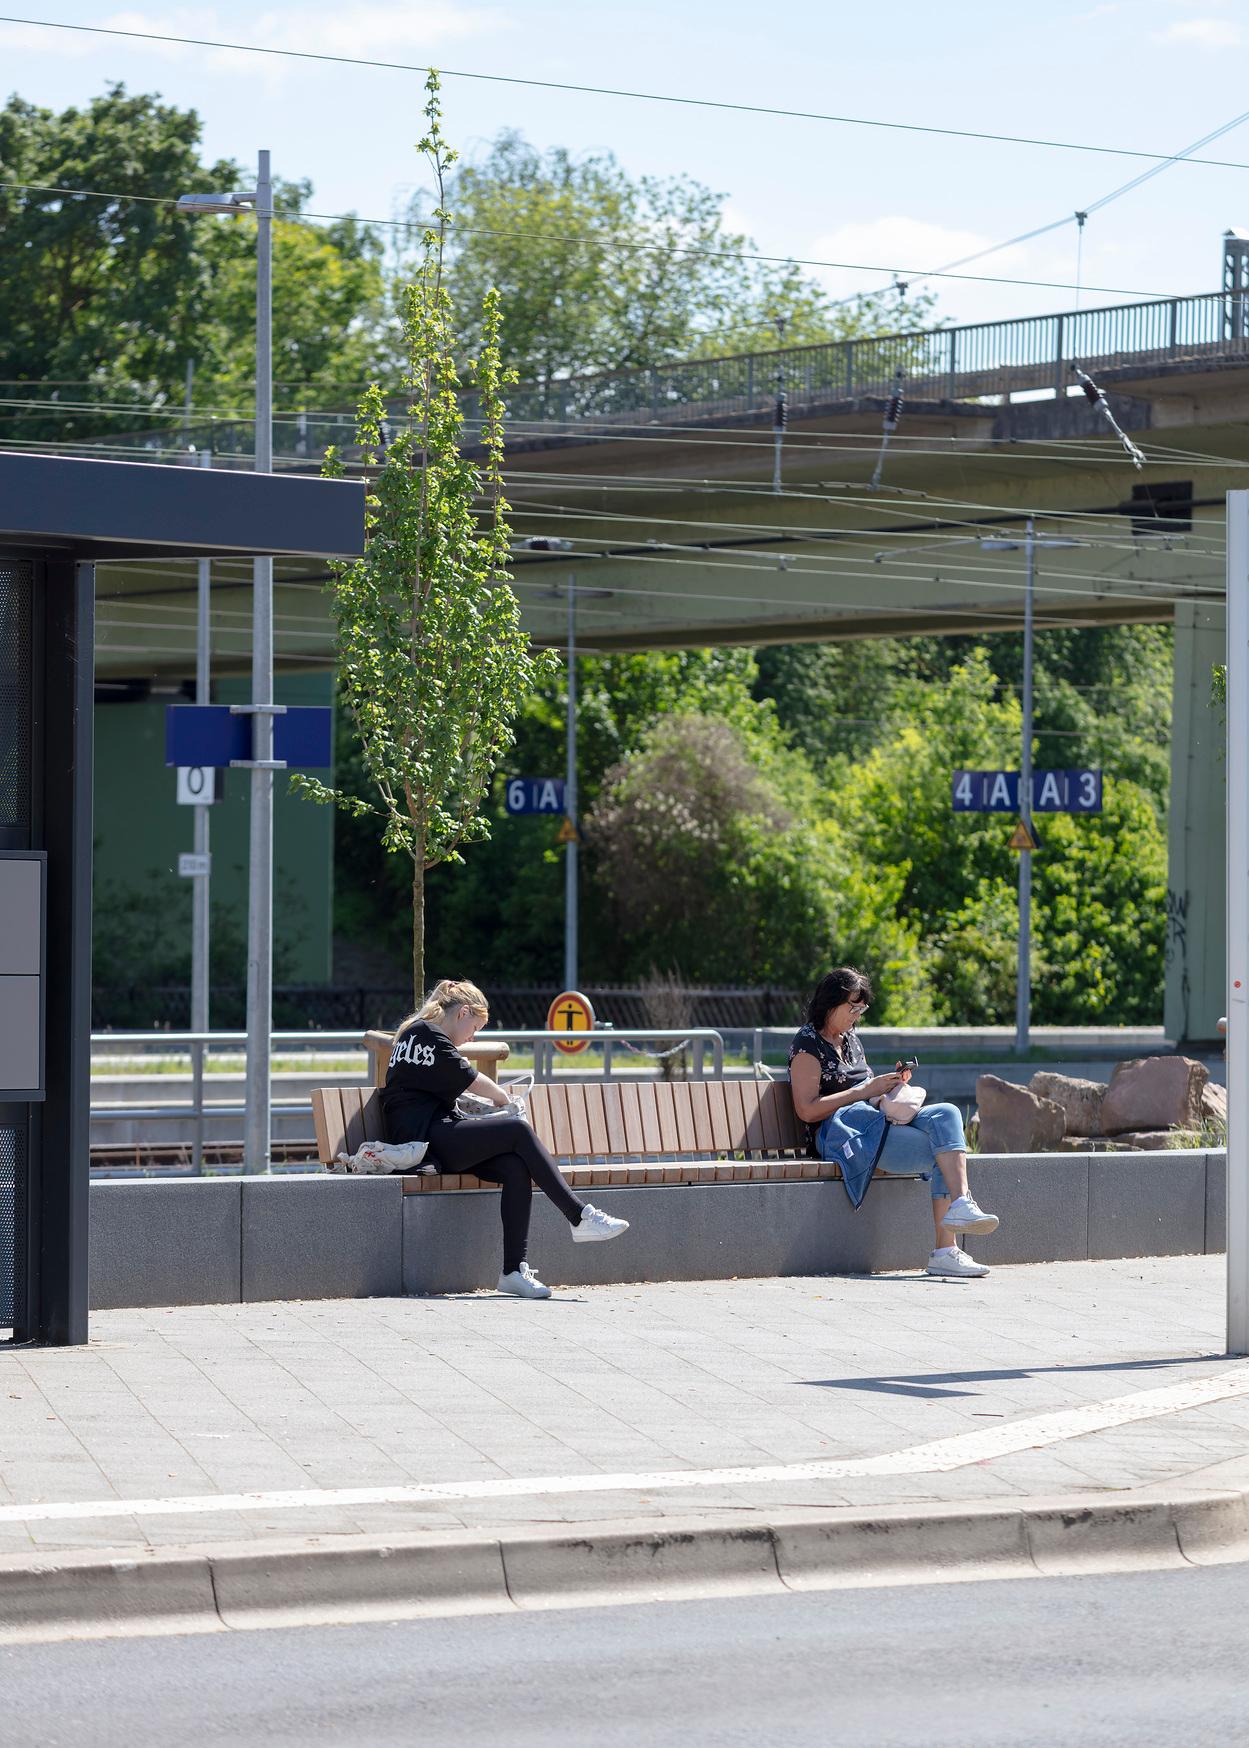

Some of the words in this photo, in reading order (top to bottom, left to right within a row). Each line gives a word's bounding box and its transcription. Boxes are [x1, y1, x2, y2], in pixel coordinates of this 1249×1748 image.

[508, 780, 525, 810] 6
[539, 780, 558, 810] A
[955, 773, 973, 807] 4
[989, 773, 1011, 807] A
[1039, 772, 1061, 806] A
[1078, 772, 1097, 807] 3
